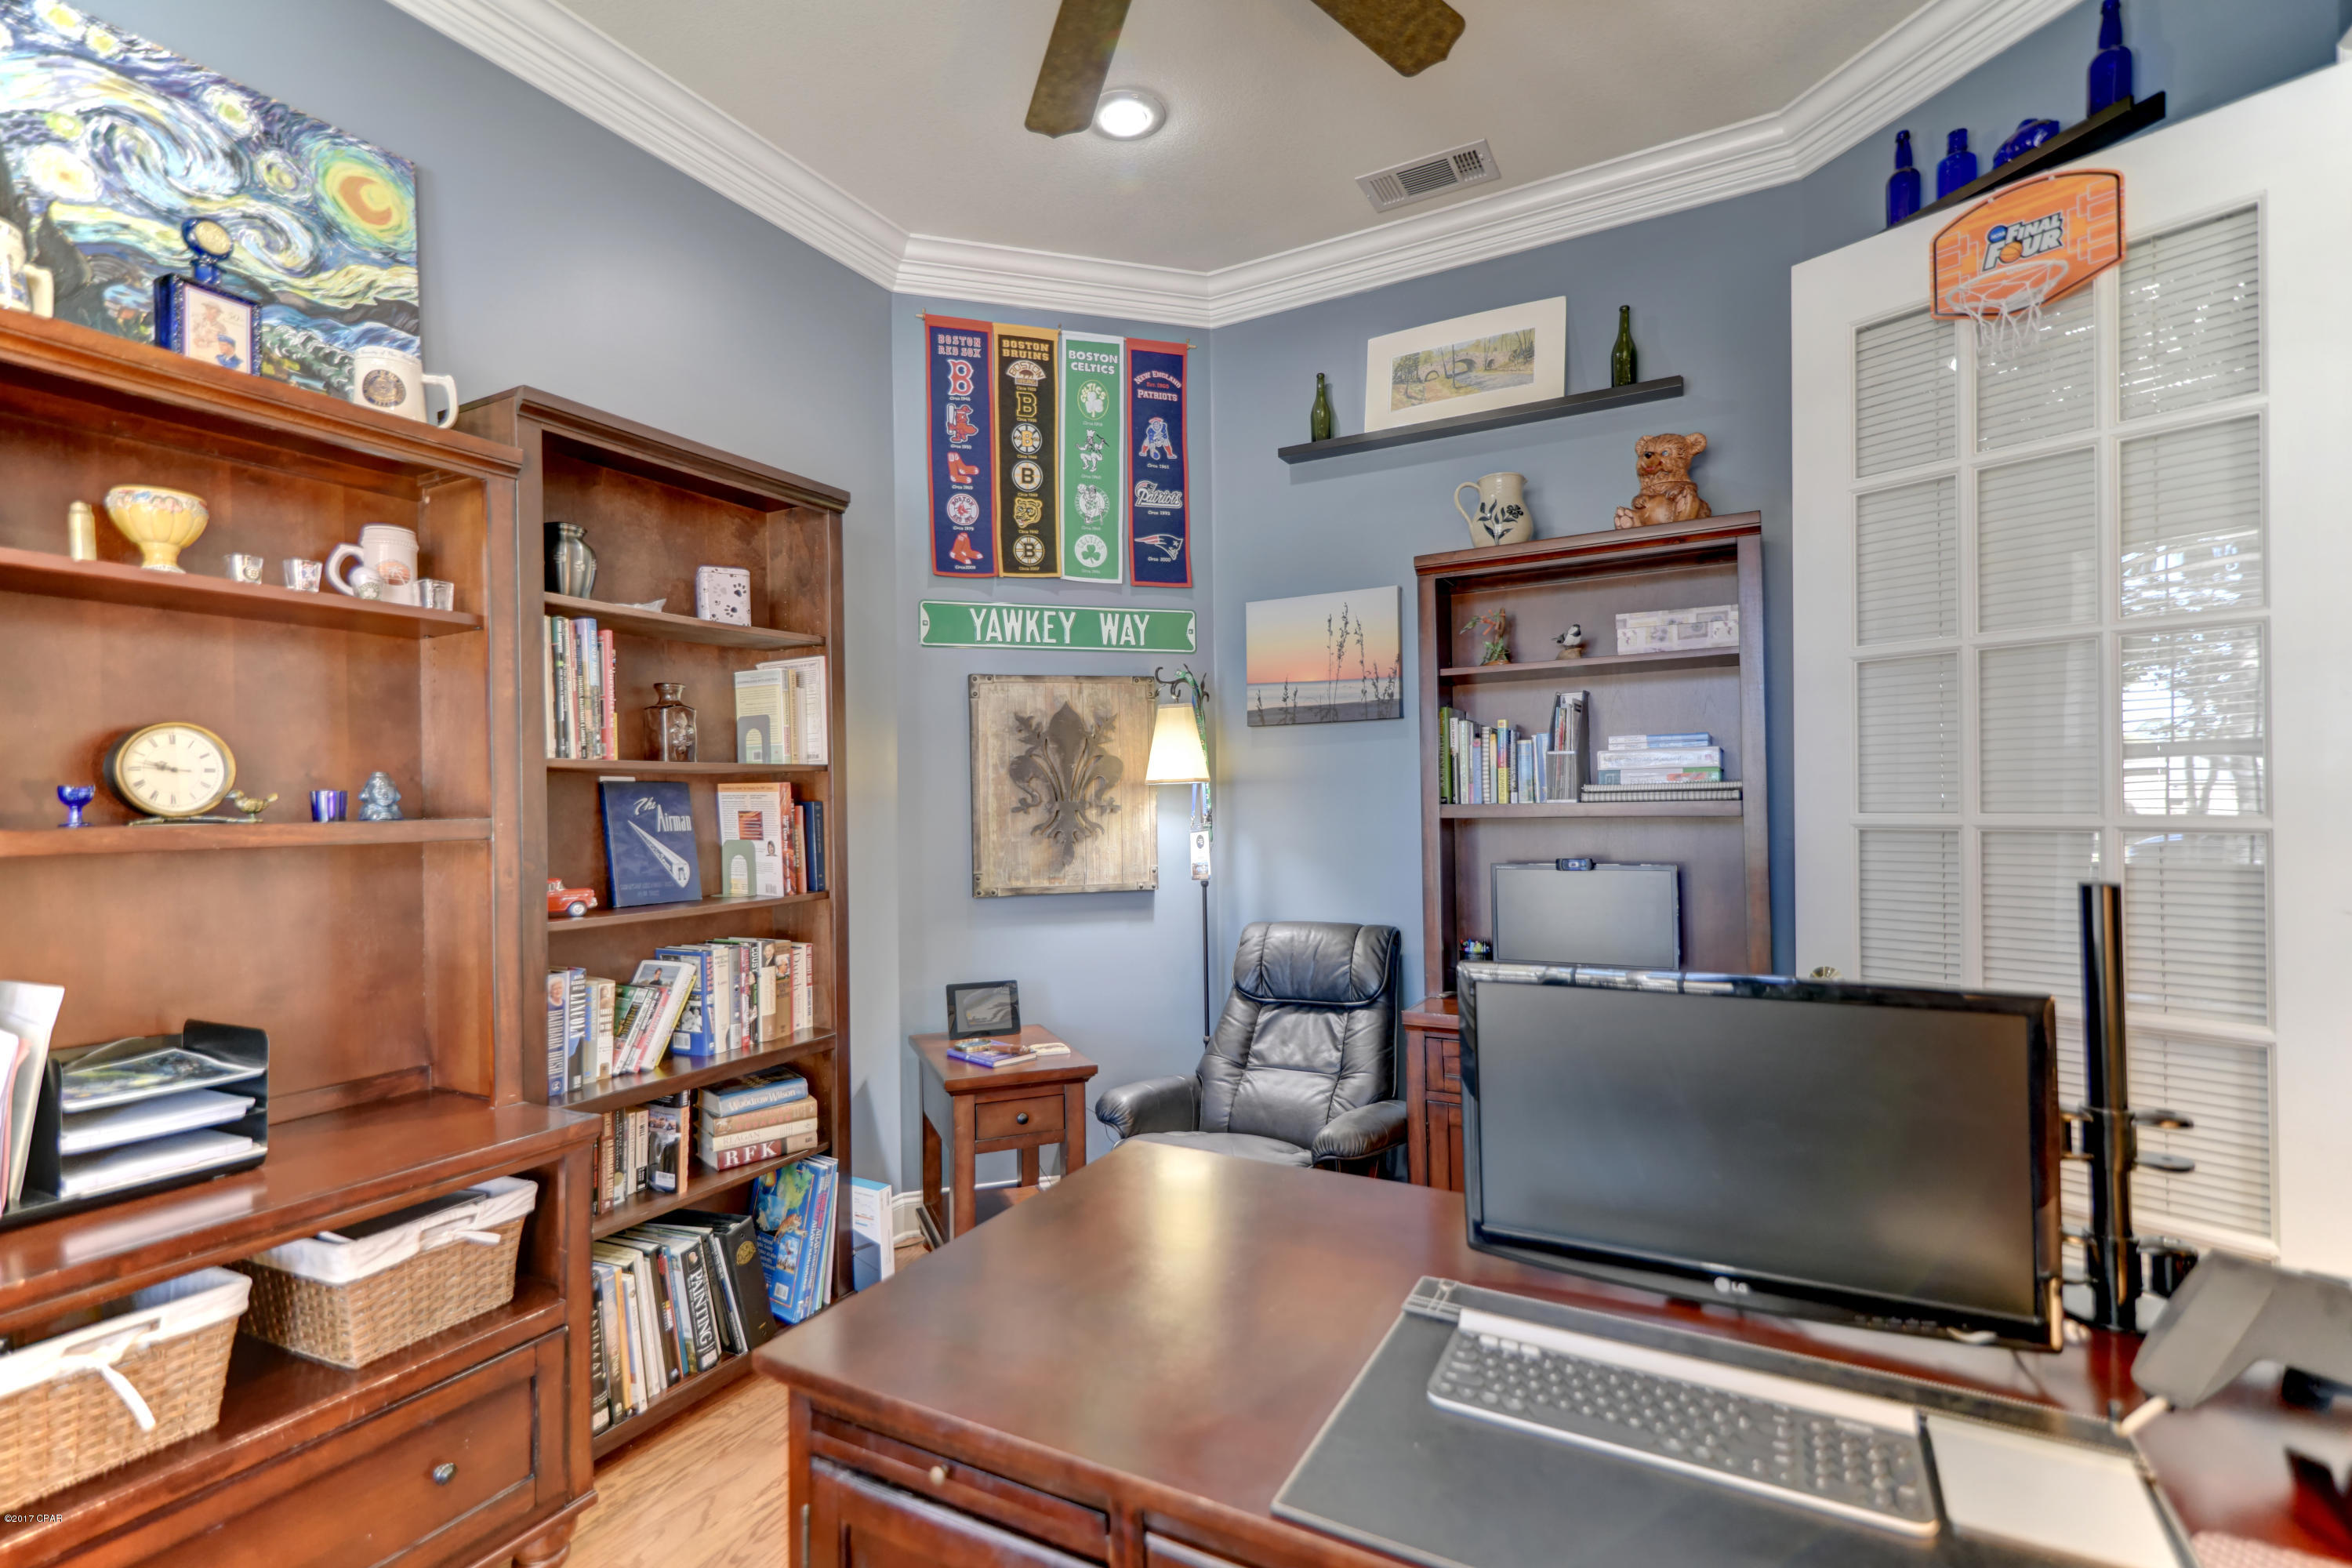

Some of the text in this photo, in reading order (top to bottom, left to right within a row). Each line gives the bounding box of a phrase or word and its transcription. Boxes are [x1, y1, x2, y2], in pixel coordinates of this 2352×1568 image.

[2006, 212, 2062, 244] FINAL
[1984, 227, 2062, 271] FOUR
[938, 334, 981, 347] BOSTON
[1002, 339, 1050, 352] BOSTON
[938, 345, 981, 358] RED SOX
[1002, 348, 1050, 361] BRUINS
[1069, 350, 1118, 364] BOSTON
[947, 359, 974, 395] B
[1008, 361, 1045, 379] BOSTON
[1071, 361, 1115, 375] CELTICS
[1134, 370, 1181, 389] NEW ENGLAND
[1137, 388, 1178, 401] PATRIOTS
[1016, 391, 1037, 417] B
[1021, 430, 1033, 447] B
[1022, 468, 1034, 484] B
[1137, 488, 1181, 506] Patriots
[1023, 543, 1036, 557] B
[970, 608, 1150, 645] YAWKEY WAY
[633, 797, 657, 816] The
[657, 804, 692, 833] Airman
[570, 992, 586, 1039] LINCOLN
[548, 1009, 563, 1074] BARBARA BUSH
[728, 1089, 796, 1111] Woodrow Wilson
[723, 1131, 760, 1145] REAGAN
[724, 1140, 777, 1167] RFK
[1731, 1281, 1748, 1294] LG
[691, 1267, 712, 1345] PAINTING
